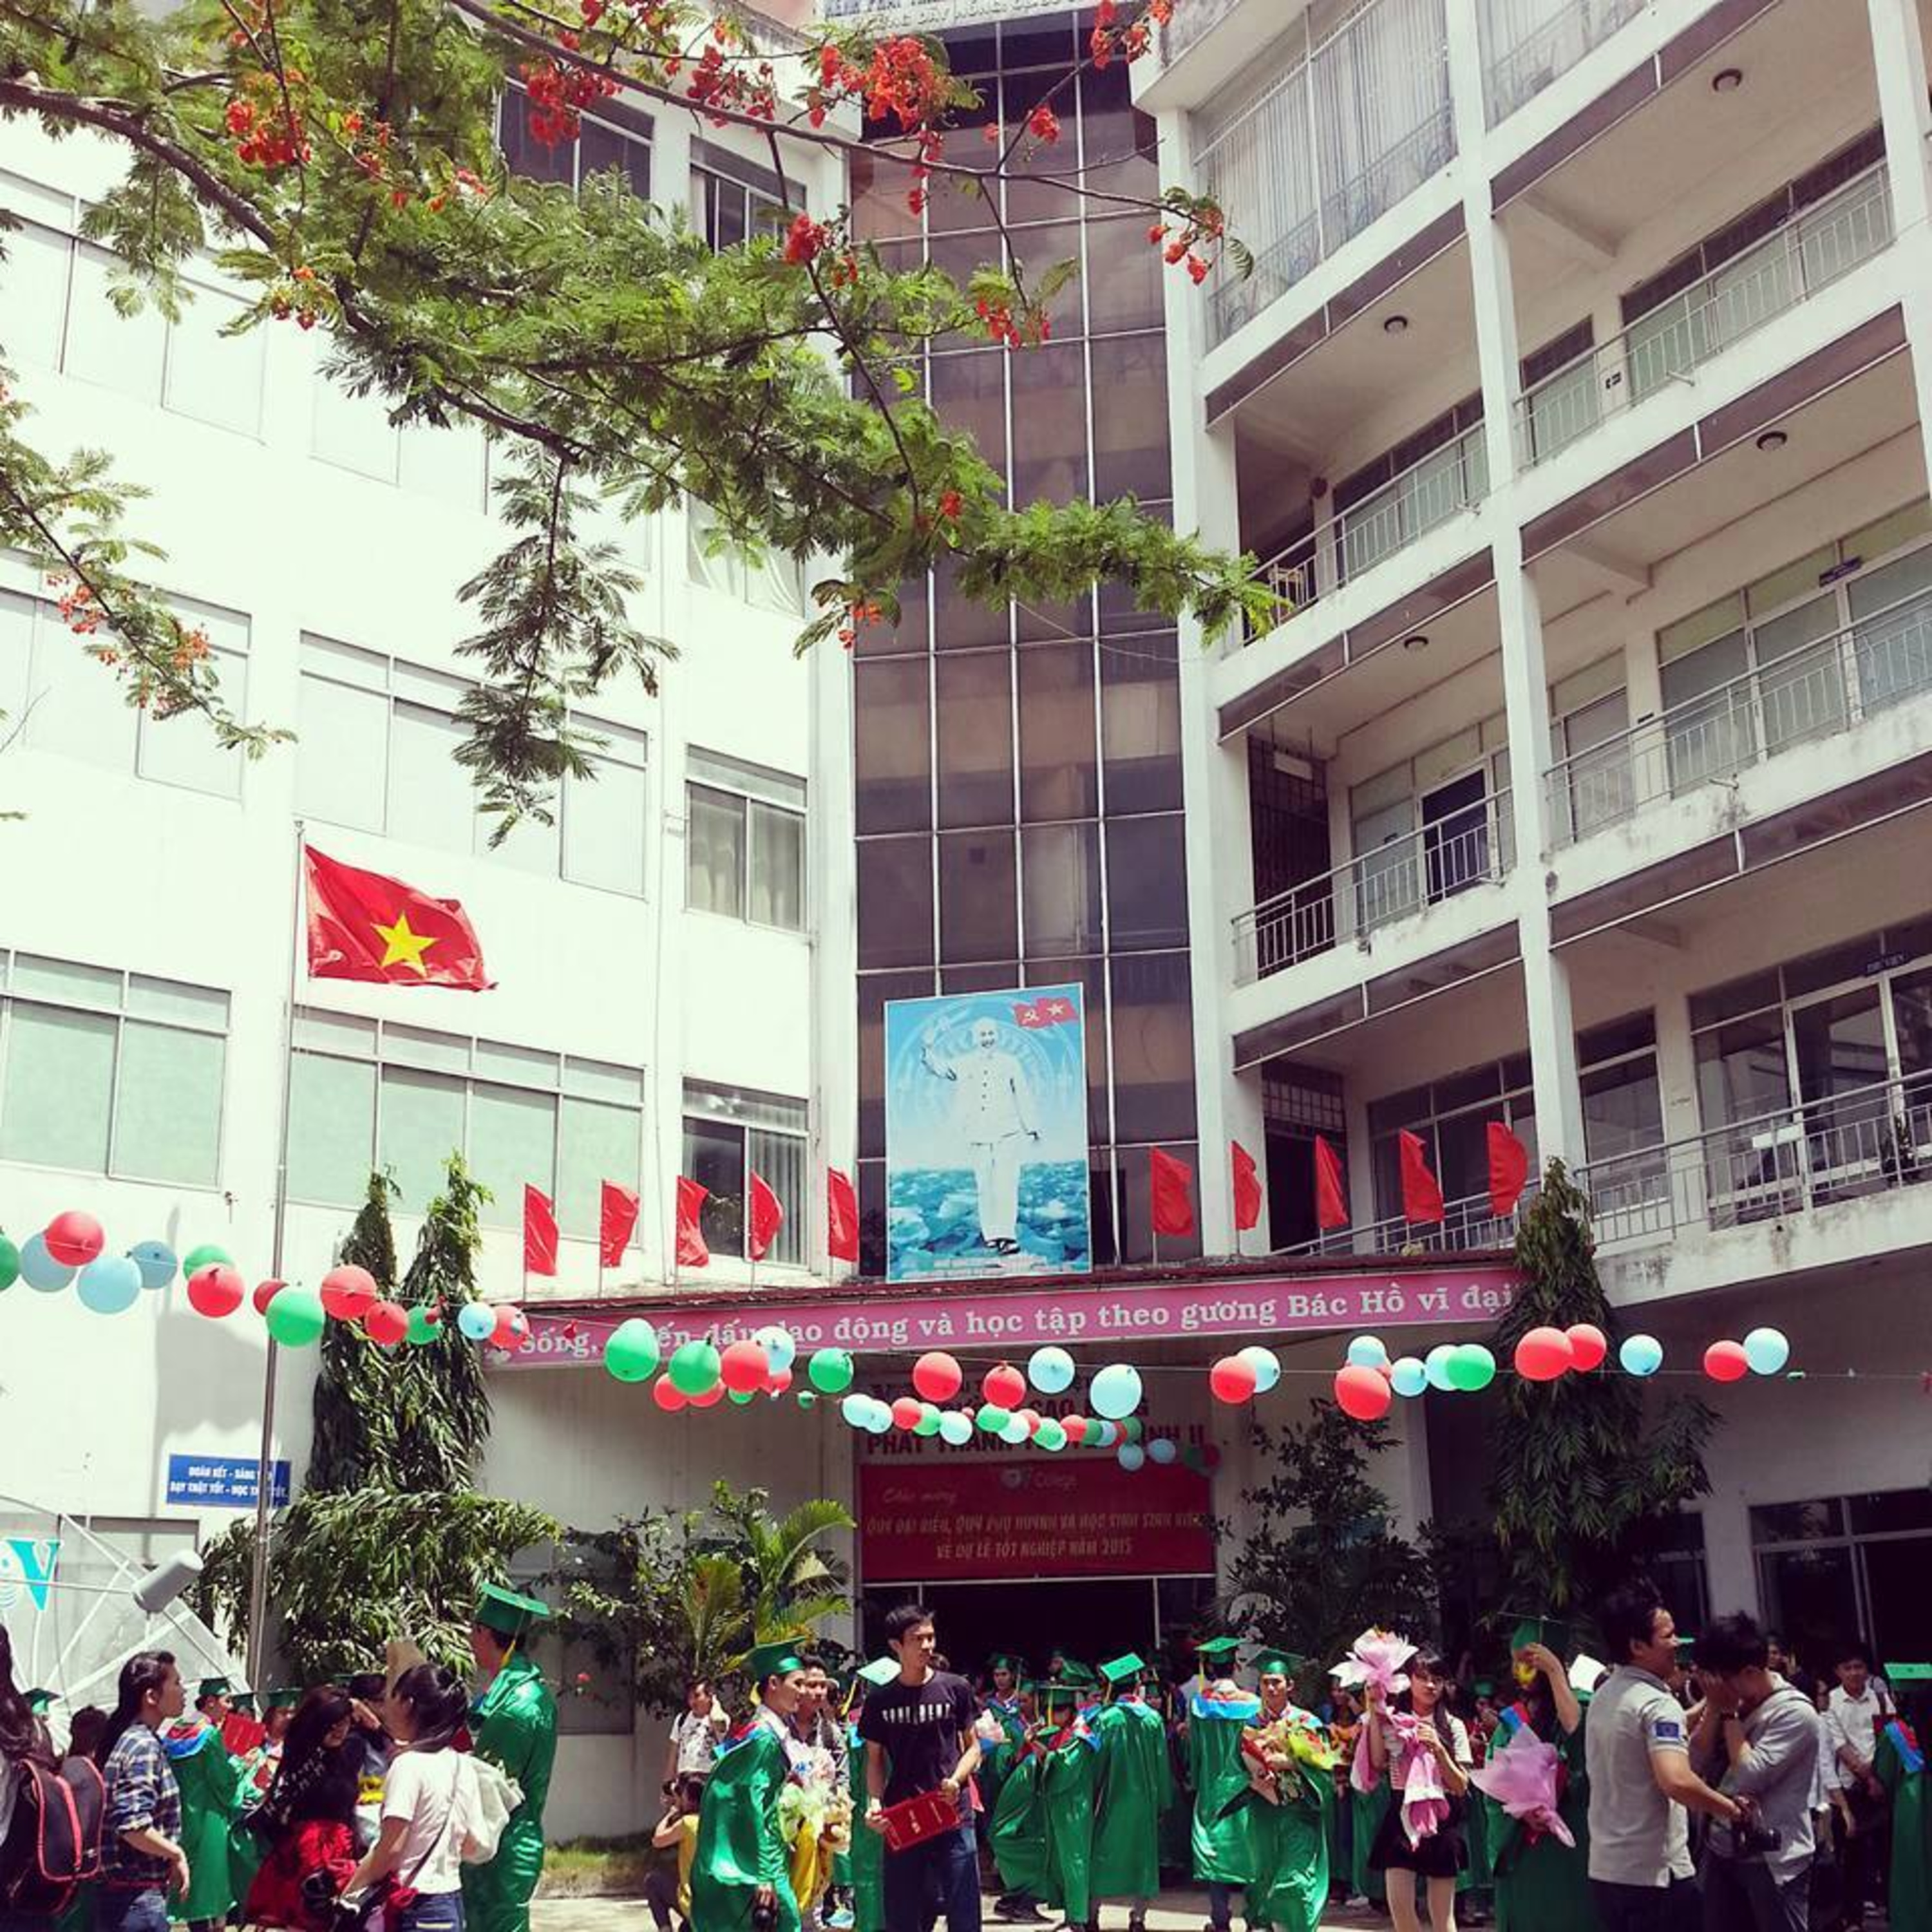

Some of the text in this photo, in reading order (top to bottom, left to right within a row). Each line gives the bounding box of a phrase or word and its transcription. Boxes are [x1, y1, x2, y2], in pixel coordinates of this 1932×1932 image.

[835, 1317, 909, 1344] động
[918, 1312, 954, 1336] và
[965, 1311, 1023, 1338] học
[1034, 1307, 1085, 1335] tập
[1098, 1304, 1170, 1327] theo
[1182, 1300, 1276, 1330] gương
[1288, 1293, 1347, 1317] Bác
[1359, 1282, 1405, 1314] Hồ
[1417, 1287, 1450, 1311] vĩ
[1461, 1283, 1513, 1313] đại
